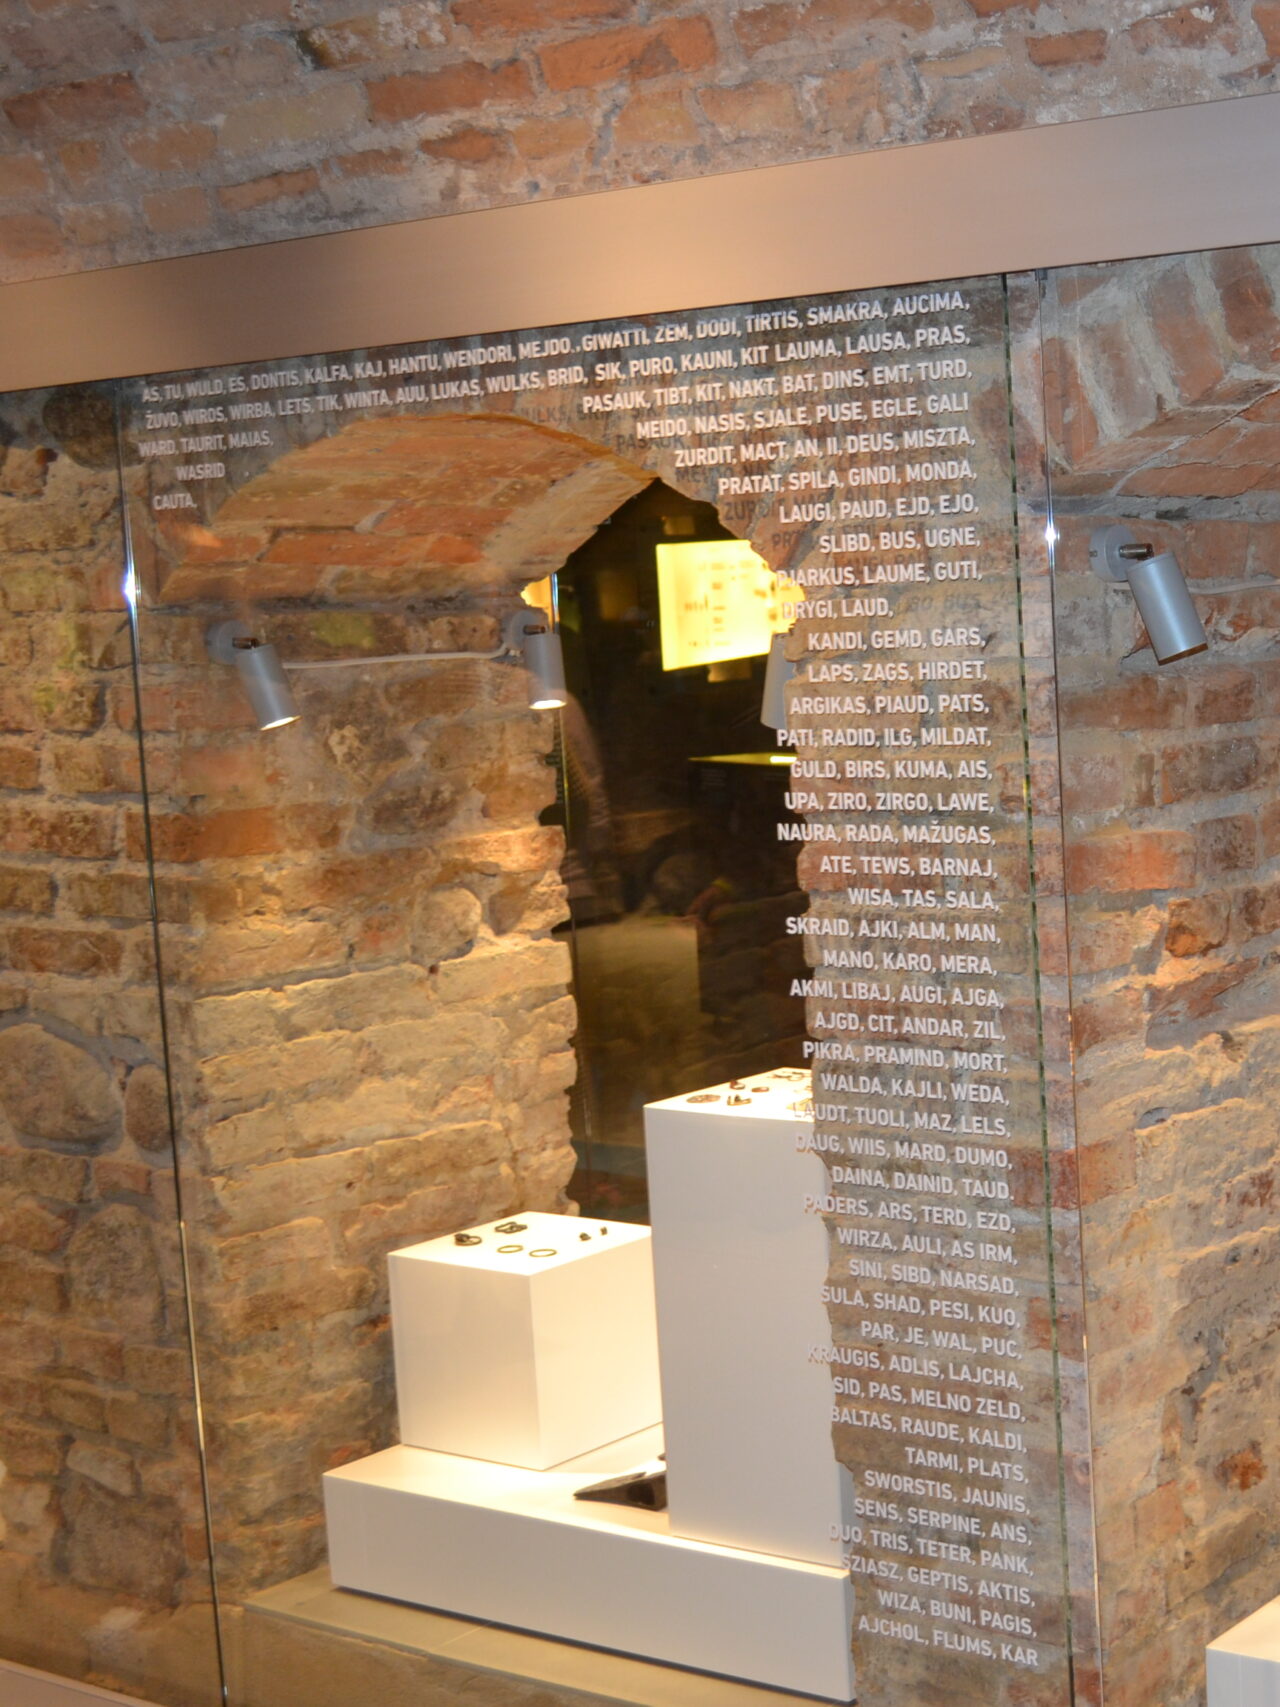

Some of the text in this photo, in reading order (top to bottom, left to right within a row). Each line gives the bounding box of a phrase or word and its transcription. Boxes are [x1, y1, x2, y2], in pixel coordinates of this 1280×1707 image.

[582, 330, 650, 352] GIWATTI,
[655, 323, 692, 344] ZEM,
[696, 317, 740, 339] DODI,
[746, 310, 802, 333] TIRTIS,
[807, 300, 888, 327] SMAKRA,
[893, 290, 970, 317] AUCIMA,
[486, 371, 543, 393] WULKS,
[547, 366, 587, 387] BRID,
[595, 361, 625, 382] SIK,
[630, 356, 677, 378] PURO,
[681, 349, 738, 373] KAUNI,
[775, 339, 841, 363] LAUMA,
[845, 331, 910, 356] LAUSA,
[915, 325, 970, 349] PRAS,
[582, 358, 971, 413] PASAUK, TIBT, KIT, NAKT, BAT, DINS, EMT, TURD,
[637, 393, 968, 439] MEIDO, NASIS, SJALE, PUSE, EGLE, GALI
[674, 426, 975, 467] ZURDIT, MACT, AN, II, DEUS, MISZTA,
[719, 461, 977, 495] PRATAT, SPILA, GINDI, MONDA,
[780, 494, 978, 523] LAUGI, PAUD, EJD, EJO,
[820, 527, 980, 553] SLIBD, BUS, UGNE,
[791, 694, 989, 715] ARGIKAS, PIAUD, PATS,
[777, 727, 990, 748] PATI, RADID, ILG, MILDAT,
[784, 792, 994, 813] UPA, ZIRO, ZIRGO, LAWE,
[777, 821, 996, 846] NAURA, RADA, MAŽUGAS,
[790, 980, 1004, 1010] AKMI, LIBAJ, AUGI, AJGA,
[815, 1012, 1006, 1042] AJGD, CIT, ANDAR, ZIL,
[821, 1074, 1009, 1107] WALDA, KAJLI, WEDA,
[796, 1132, 1012, 1170] DAUG, WIIS, MARD, DUMO,
[837, 1228, 1018, 1266] WIRZA, AULI, AS IRM,
[821, 1286, 1020, 1329] SULA, SHAD, PESI, KUO,
[808, 1344, 1023, 1392] KRAUGIS, ADLIS, LAJCHA,
[865, 1470, 1030, 1516] SWORSTIS, JAUNIS,
[855, 1499, 1032, 1546] SENS, SERPINE, ANS,
[859, 1616, 1038, 1666] AJCHOL, FLUMS, KAR
